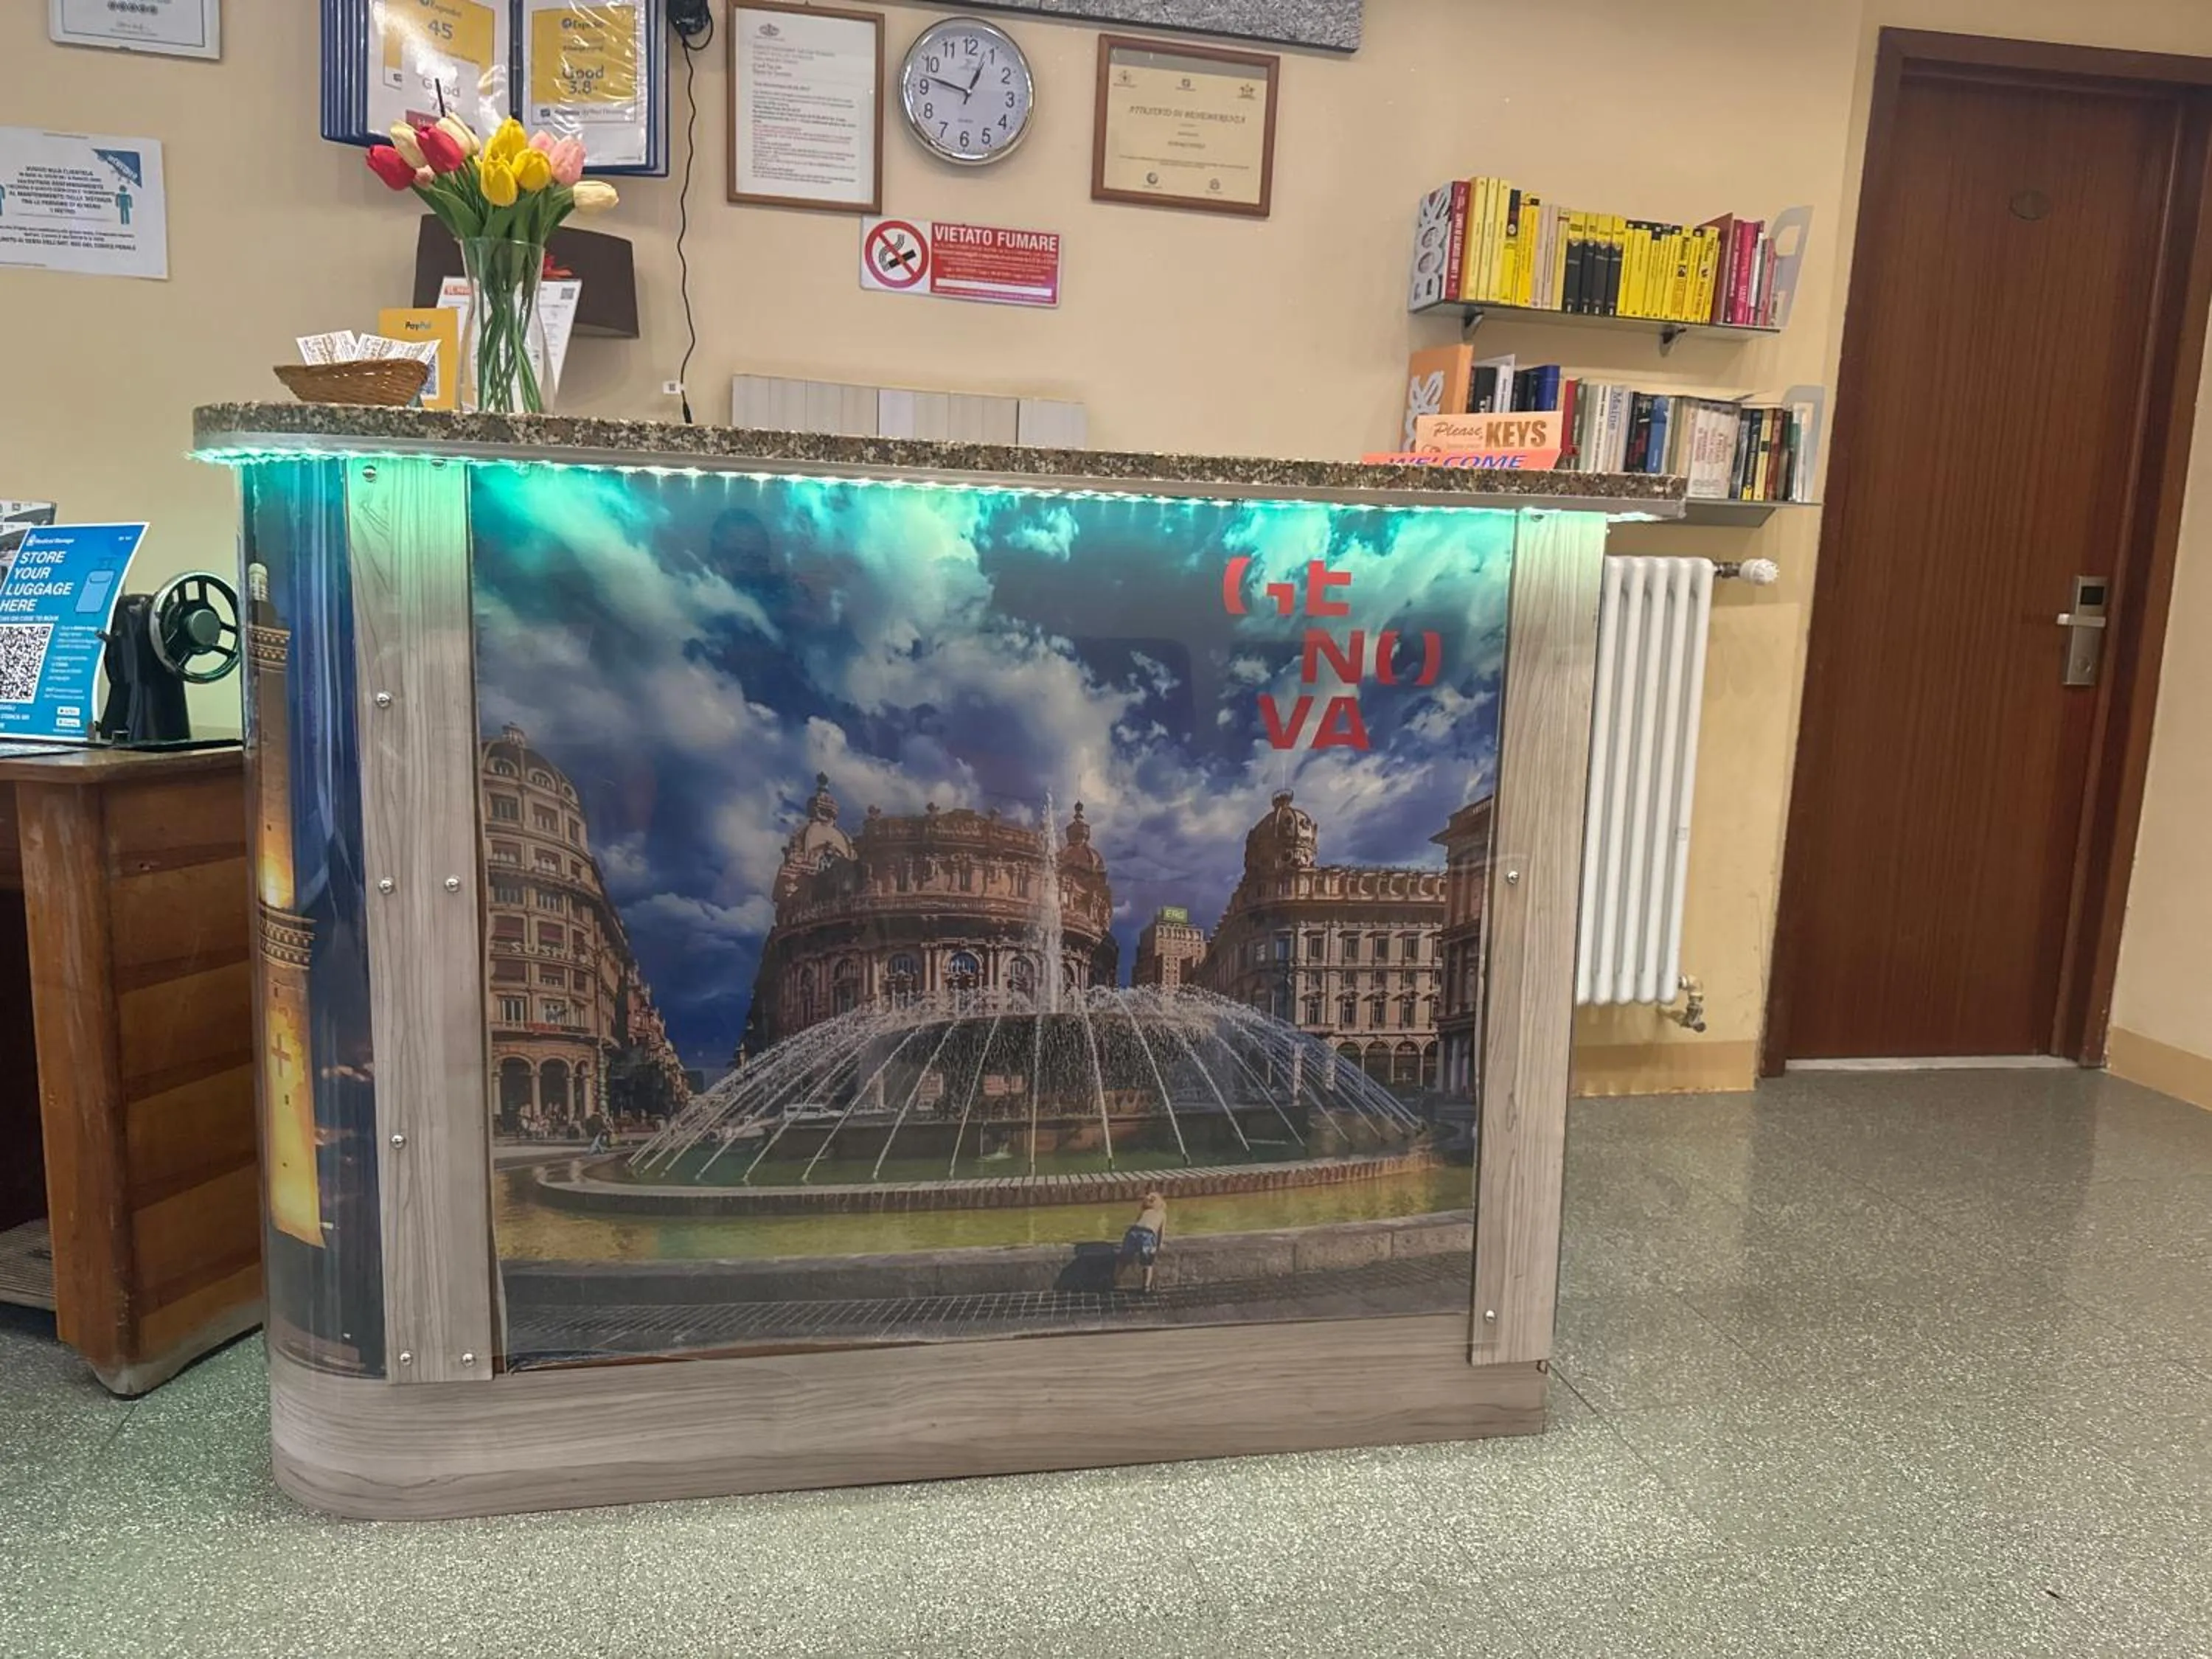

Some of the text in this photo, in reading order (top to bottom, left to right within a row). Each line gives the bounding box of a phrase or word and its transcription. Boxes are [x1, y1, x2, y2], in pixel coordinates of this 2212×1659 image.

[942, 41, 955, 59] 11
[963, 38, 978, 56] 12
[925, 55, 940, 73] 10
[989, 47, 995, 65] 1
[1001, 67, 1011, 85] 2
[422, 77, 461, 98] God
[919, 79, 929, 95] 9
[1005, 91, 1015, 108] 3
[923, 102, 933, 119] 8
[939, 122, 949, 139] 7
[998, 114, 1007, 130] 4
[959, 131, 970, 147] 6
[981, 128, 991, 145] 5
[933, 225, 1057, 251] VIETATO FUMARE
[1485, 420, 1547, 448] KEYS
[19, 551, 66, 564] STORE
[13, 567, 51, 580] YOUR
[5, 582, 74, 595] LUGGAGE
[0, 599, 38, 612] HERE
[1258, 694, 1371, 751] VA
